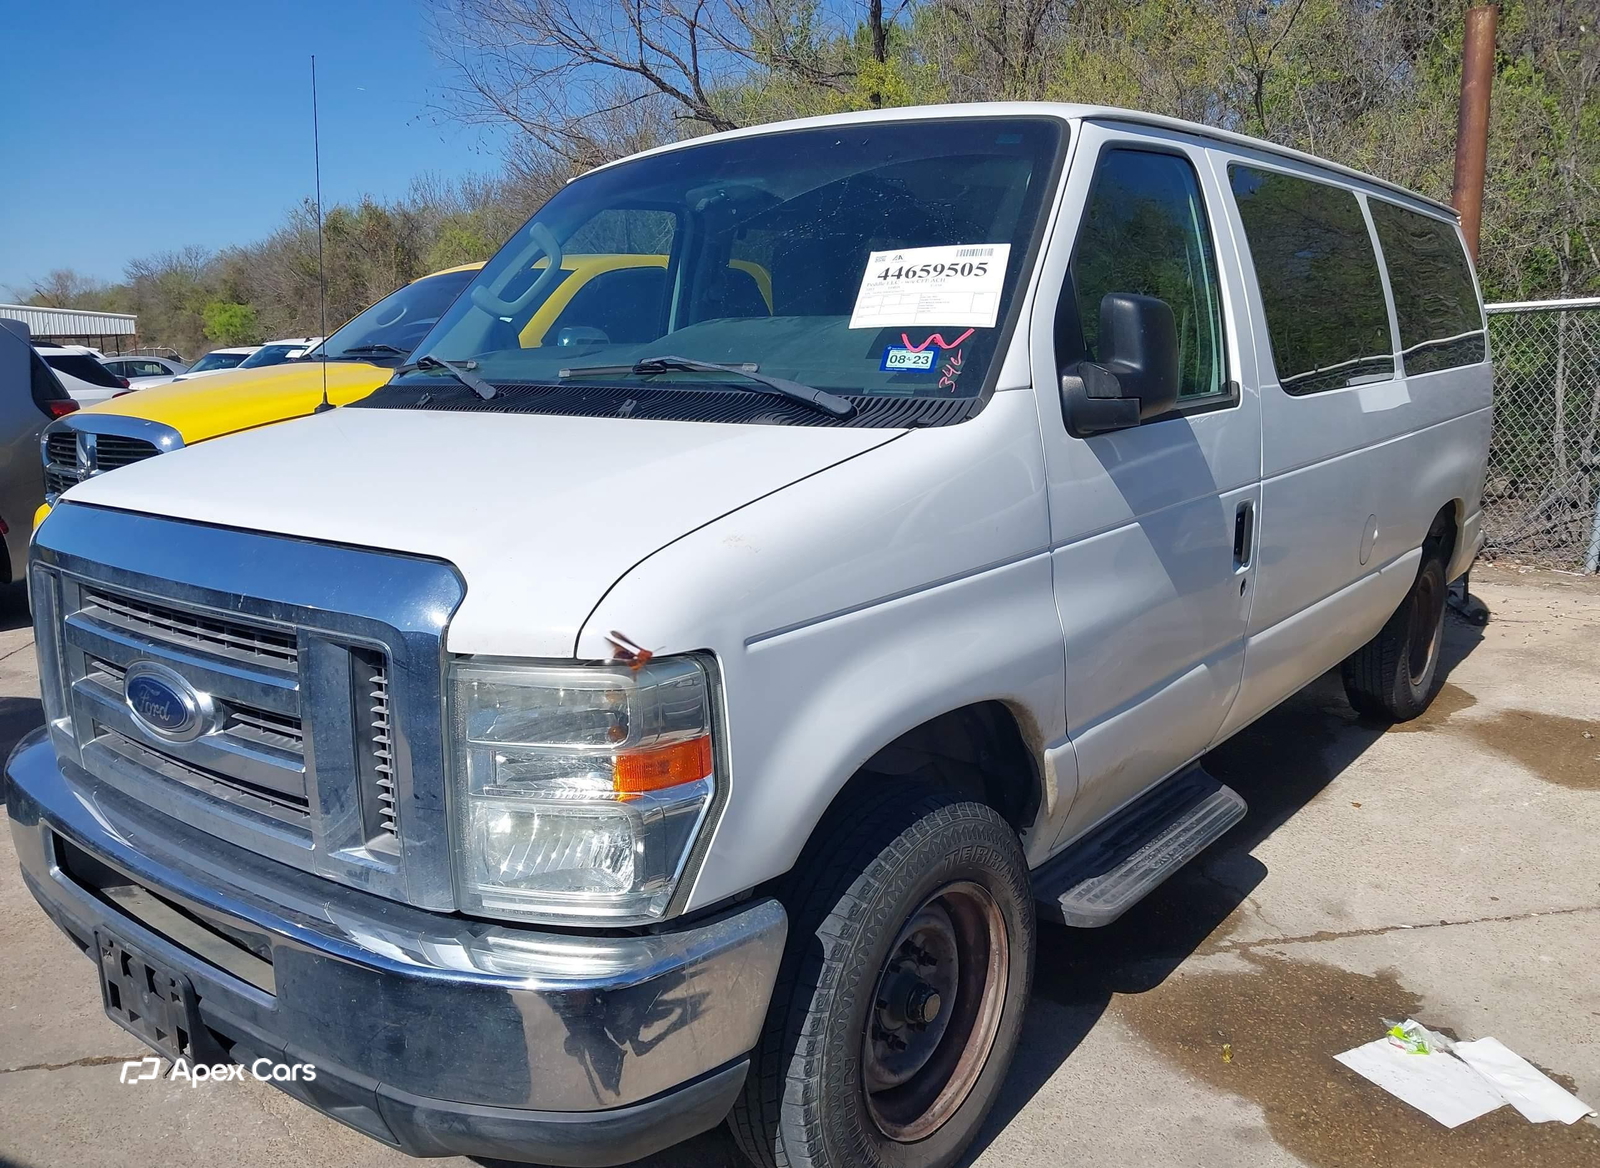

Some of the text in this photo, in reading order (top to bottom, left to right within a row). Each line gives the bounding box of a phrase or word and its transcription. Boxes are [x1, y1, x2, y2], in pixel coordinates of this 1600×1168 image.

[877, 262, 988, 280] 44659505
[889, 354, 930, 365] 08 23
[134, 684, 170, 721] Ford
